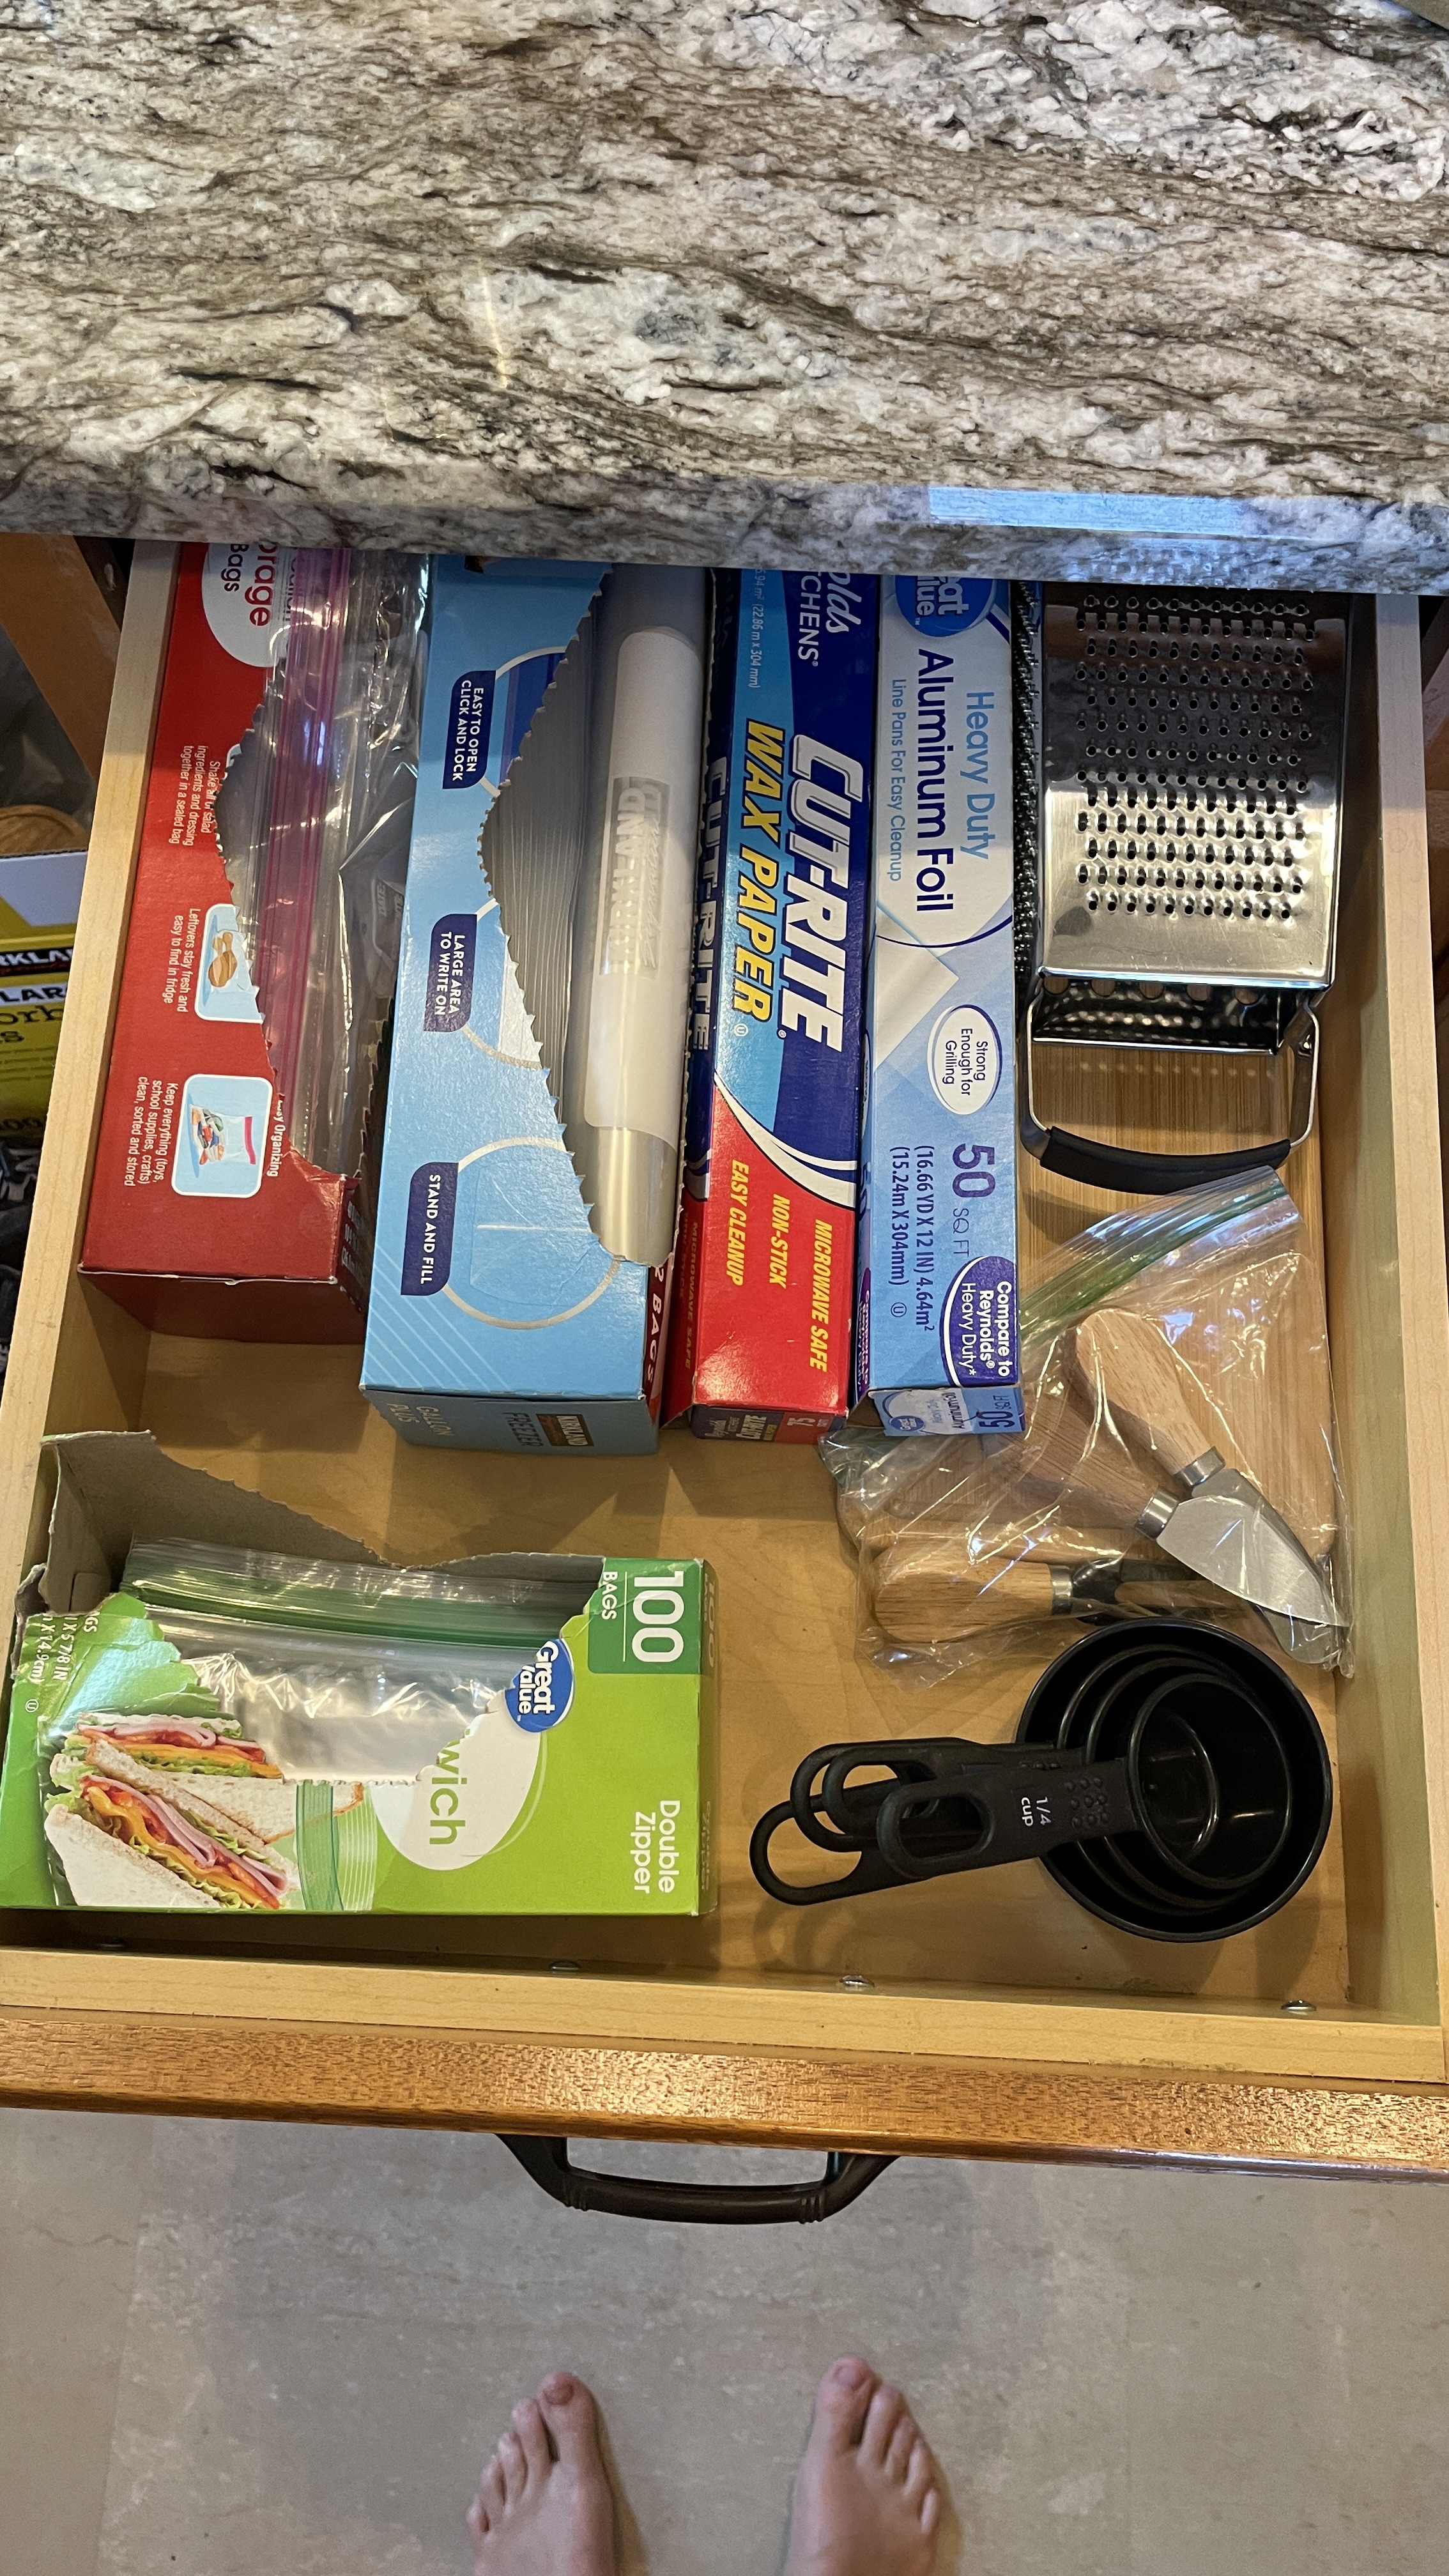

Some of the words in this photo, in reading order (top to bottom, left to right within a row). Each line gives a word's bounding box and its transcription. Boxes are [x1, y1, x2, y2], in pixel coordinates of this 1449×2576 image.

[750, 650, 762, 666] 304
[747, 668, 761, 687] mm)
[459, 680, 471, 715] CLICK
[471, 687, 484, 716] EASY
[892, 679, 906, 707] Line
[456, 718, 468, 744] AND
[470, 719, 480, 735] TO
[891, 713, 905, 746] Pans
[960, 692, 995, 784] Heavy
[466, 739, 479, 772] OPEN
[917, 648, 954, 838] Aluminum
[180, 746, 194, 780] together
[192, 745, 208, 792] ingredients
[208, 761, 221, 787] Shake
[452, 748, 466, 781] LOCK
[891, 751, 905, 772] For
[179, 782, 190, 790] in
[742, 721, 783, 842] WAX
[887, 776, 905, 810] Easy
[173, 799, 186, 827] sealed
[190, 793, 201, 810] and
[168, 829, 184, 844] bag
[182, 811, 200, 846] dressing
[200, 812, 214, 834] salad
[960, 793, 995, 859] Duty
[887, 815, 905, 881] Cleanup
[916, 848, 953, 912] Foil
[693, 756, 728, 1050] CUT-RITE
[170, 915, 184, 935] easy
[185, 908, 201, 948] Leftovers
[440, 931, 452, 949] TO
[732, 847, 777, 1020] PAPER
[171, 937, 183, 946] to
[452, 935, 465, 977] LARGE
[167, 967, 180, 976] in
[169, 949, 181, 965] find
[180, 950, 195, 969] stay
[436, 953, 450, 991] WRITE
[162, 978, 178, 1004] fridge
[180, 970, 193, 993] fresh
[449, 979, 461, 1013] AREA
[177, 995, 188, 1012] and
[434, 995, 447, 1015] ON
[942, 1040, 957, 1084] Grilling
[958, 1028, 973, 1075] Enough
[973, 1041, 988, 1080] Strong
[134, 1077, 150, 1104] clean,
[149, 1080, 163, 1110] school
[162, 1082, 178, 1105] Keep
[961, 1079, 973, 1096] for
[130, 1107, 145, 1135] sorted
[141, 1112, 158, 1152] supplies,
[155, 1108, 174, 1155] everything
[127, 1137, 141, 1154] and
[266, 1124, 286, 1177] Organizing
[123, 1157, 138, 1186] stored
[137, 1154, 153, 1184] crafts)
[153, 1158, 168, 1183] (toys,
[730, 1160, 749, 1207] EASY
[889, 1146, 910, 1207] (15.24m
[914, 1146, 935, 1192] (16.66
[952, 1143, 996, 1198] 50
[426, 1174, 441, 1219] STAND
[916, 1195, 934, 1213] YD
[892, 1210, 909, 1220] X
[916, 1216, 933, 1227] X
[953, 1208, 969, 1234] SQ
[424, 1222, 436, 1253] AND
[726, 1207, 747, 1285] CLEANUP
[769, 1193, 790, 1289] NON-STICK
[916, 1230, 933, 1247] 12
[953, 1240, 969, 1257] FT
[889, 1223, 910, 1285] 304mm)
[914, 1252, 935, 1273] IN)
[420, 1257, 434, 1284] FILL
[811, 1219, 832, 1324] MICROWAVE
[958, 1282, 976, 1331] Heavy
[994, 1281, 1012, 1356] Compare
[647, 1293, 662, 1383] BAGS
[809, 1325, 829, 1372] SAFE
[998, 1360, 1013, 1377] to
[386, 1403, 420, 1423] PLUS
[415, 1406, 456, 1436] GALLON
[976, 1411, 1015, 1428] 50
[502, 1413, 544, 1447] FREEZER
[556, 1415, 588, 1446] KIRKLAND
[601, 1571, 618, 1620] BAGS
[632, 1570, 684, 1662] 100
[53, 1666, 68, 1680] IN
[533, 1641, 559, 1714] Great
[1022, 1797, 1034, 1827] cup
[1036, 1797, 1052, 1825] 1/4
[630, 1812, 656, 1894] Zipper
[658, 1800, 680, 1893] Double
